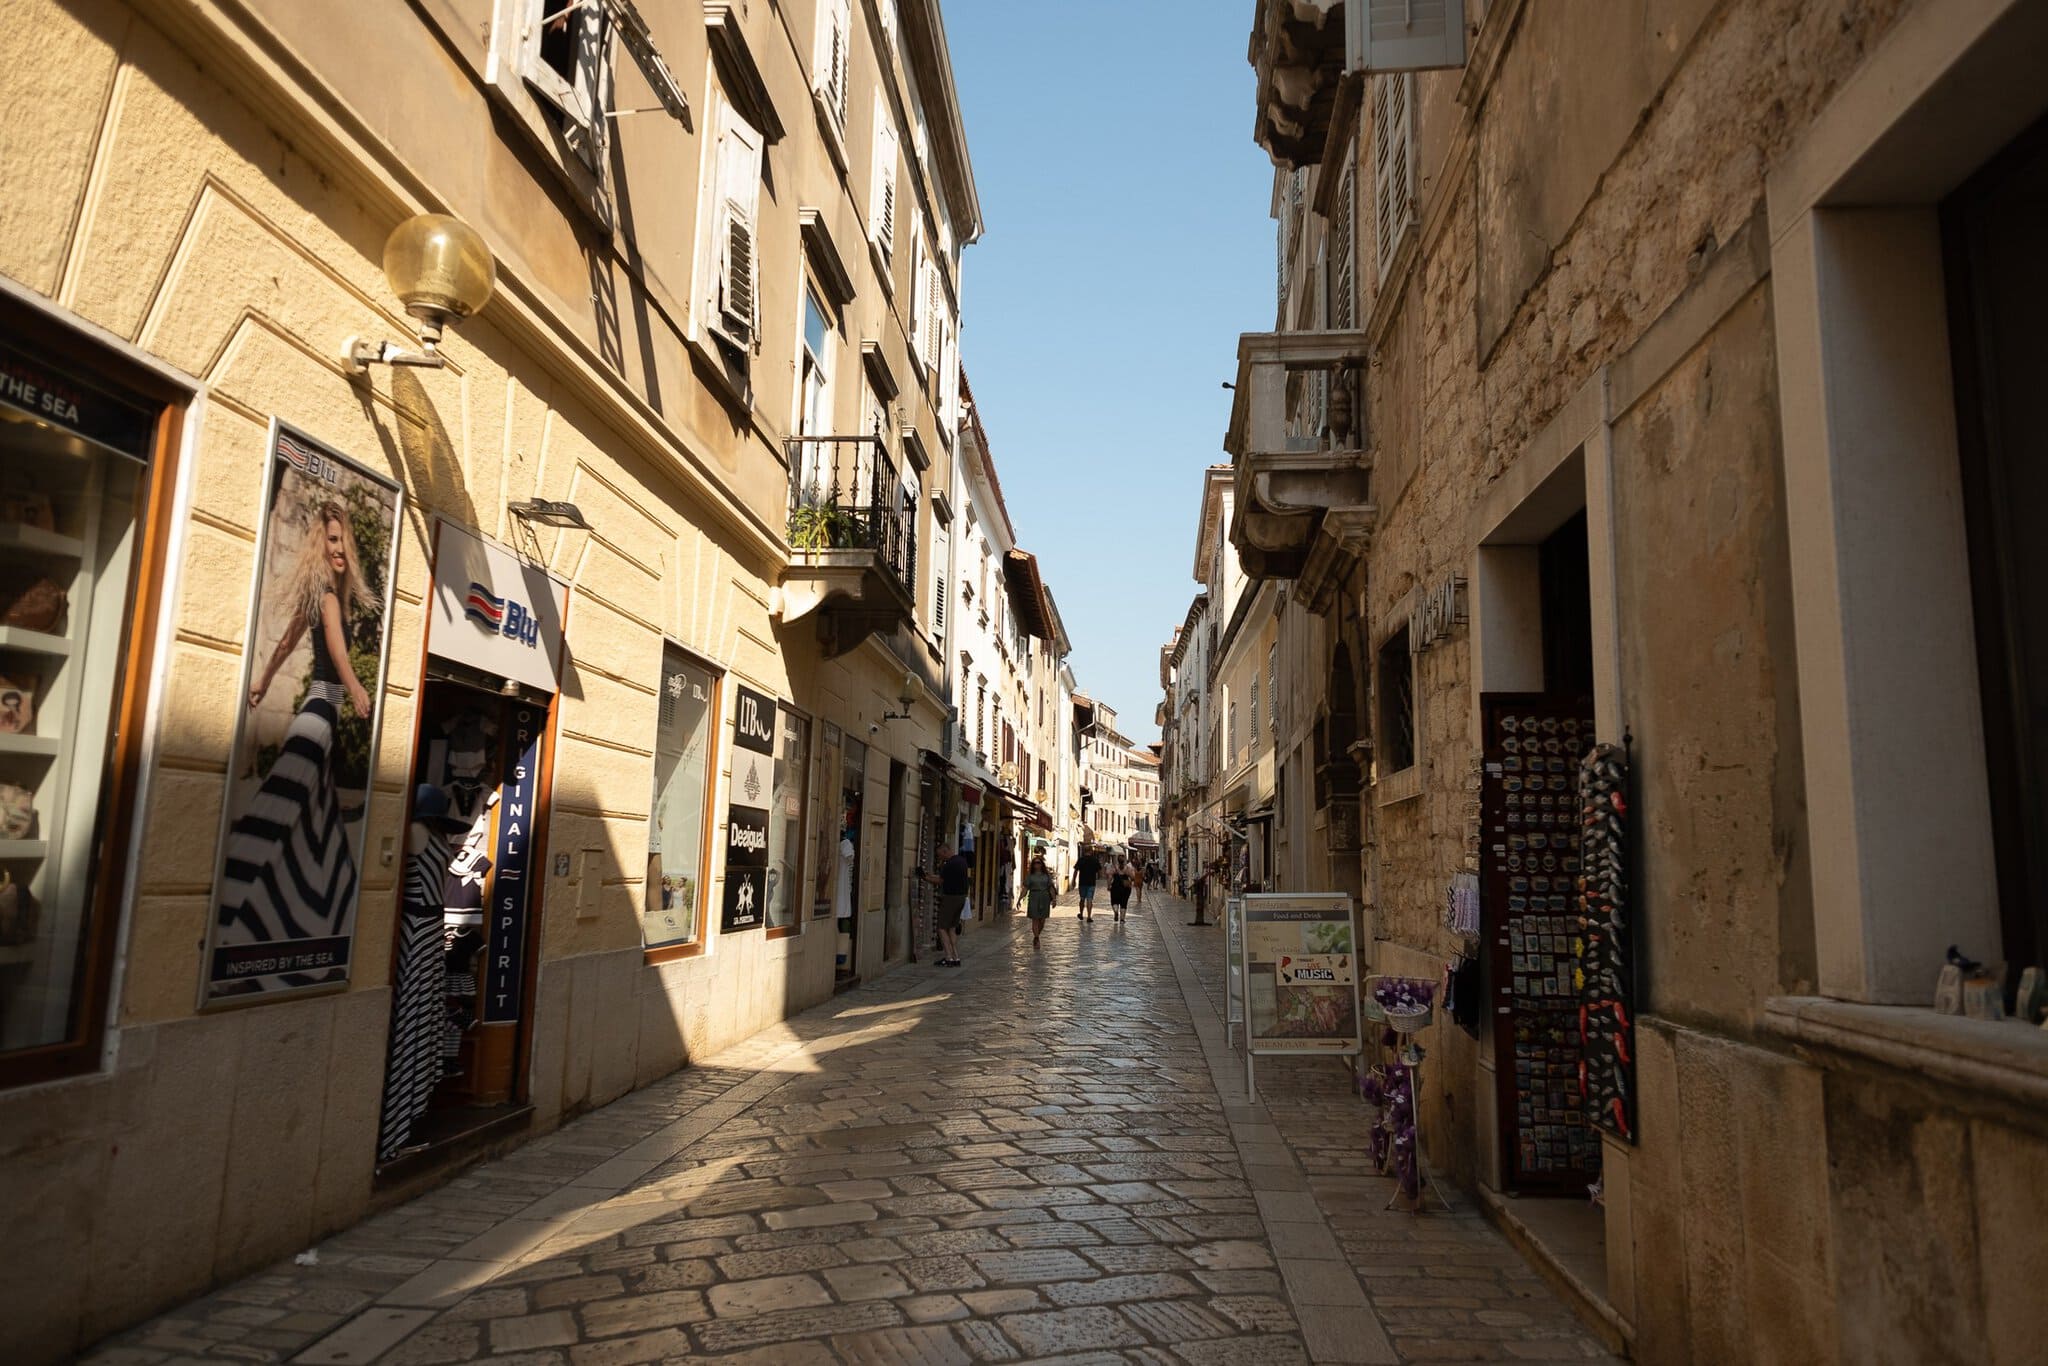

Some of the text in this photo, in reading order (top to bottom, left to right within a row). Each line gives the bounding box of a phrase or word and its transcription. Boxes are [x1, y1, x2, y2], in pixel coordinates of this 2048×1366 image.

[40, 392, 80, 424] SEA
[309, 453, 336, 484] Blu
[503, 600, 540, 650] Blu
[507, 711, 529, 855] ORIGINAL
[226, 951, 335, 977] INSPIRED BY THE SEA
[495, 897, 513, 1008] SPIRIT
